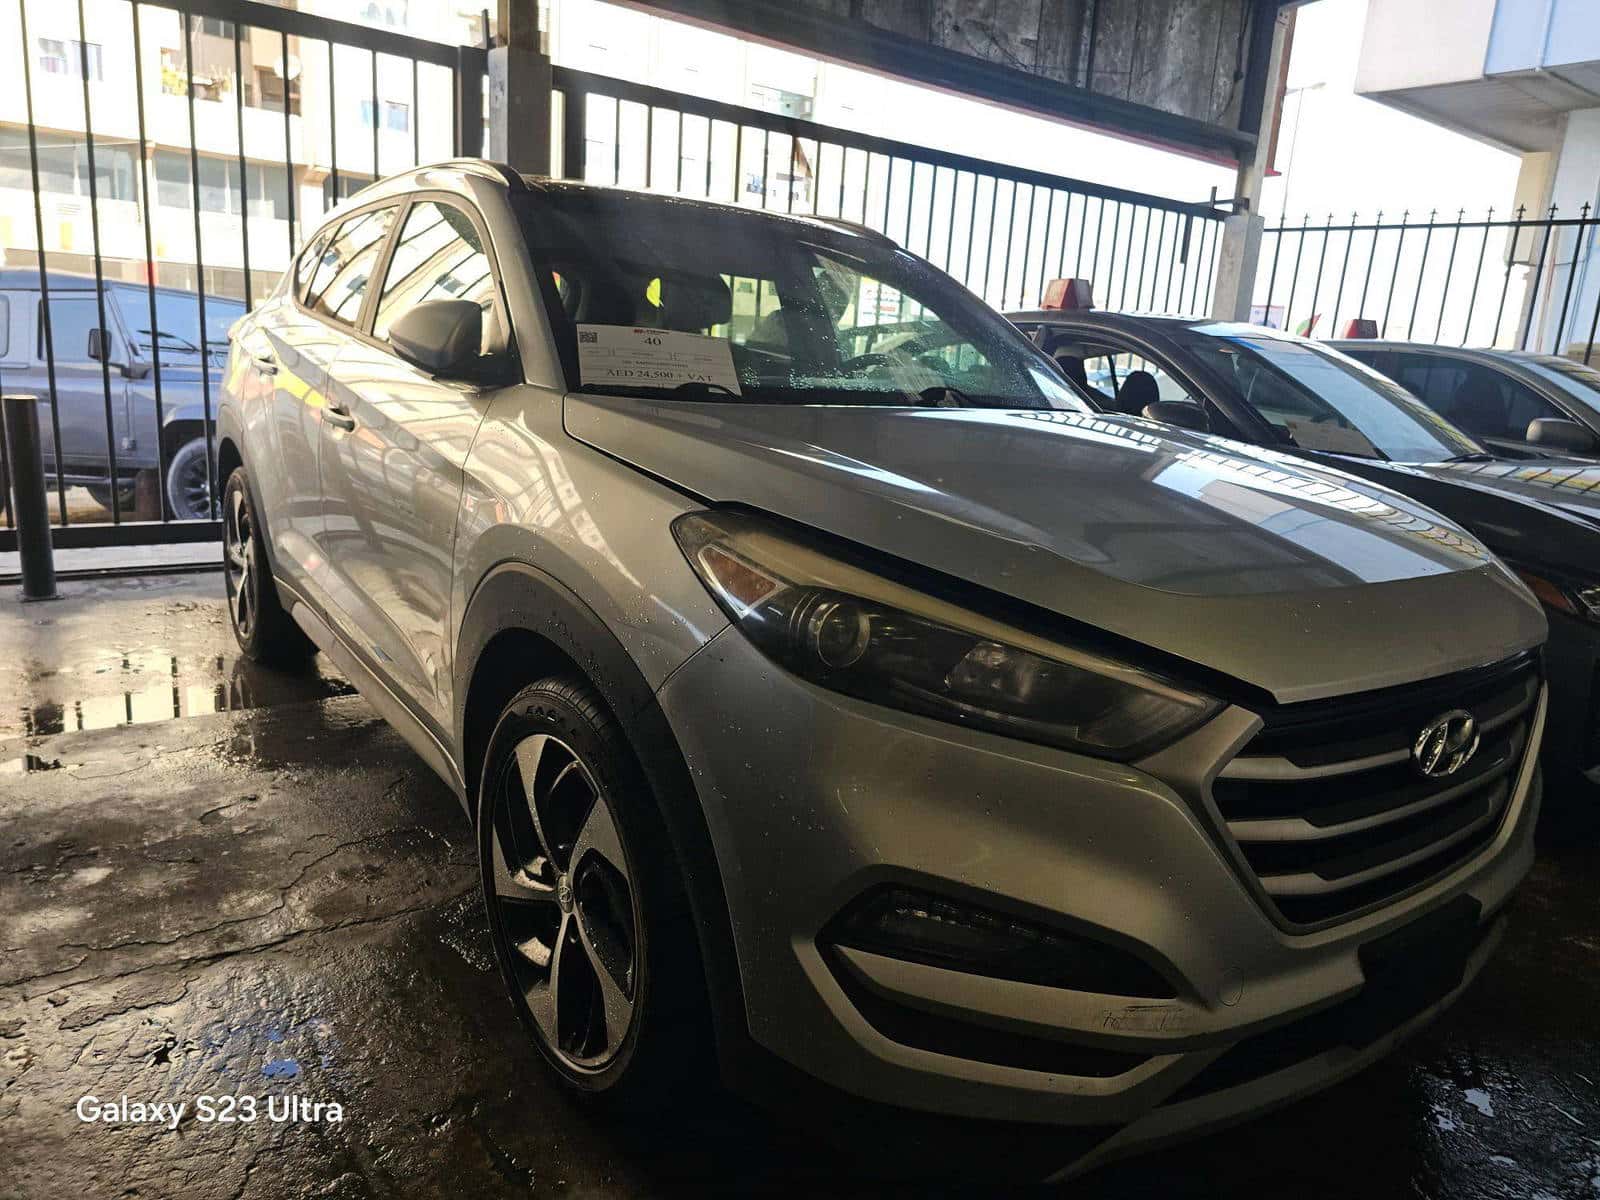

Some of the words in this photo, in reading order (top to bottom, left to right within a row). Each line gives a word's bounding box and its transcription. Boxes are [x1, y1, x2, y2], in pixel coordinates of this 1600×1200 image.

[642, 337, 662, 346] 40
[607, 369, 634, 378] AED
[637, 370, 673, 380] 24,500
[687, 374, 714, 383] VAT
